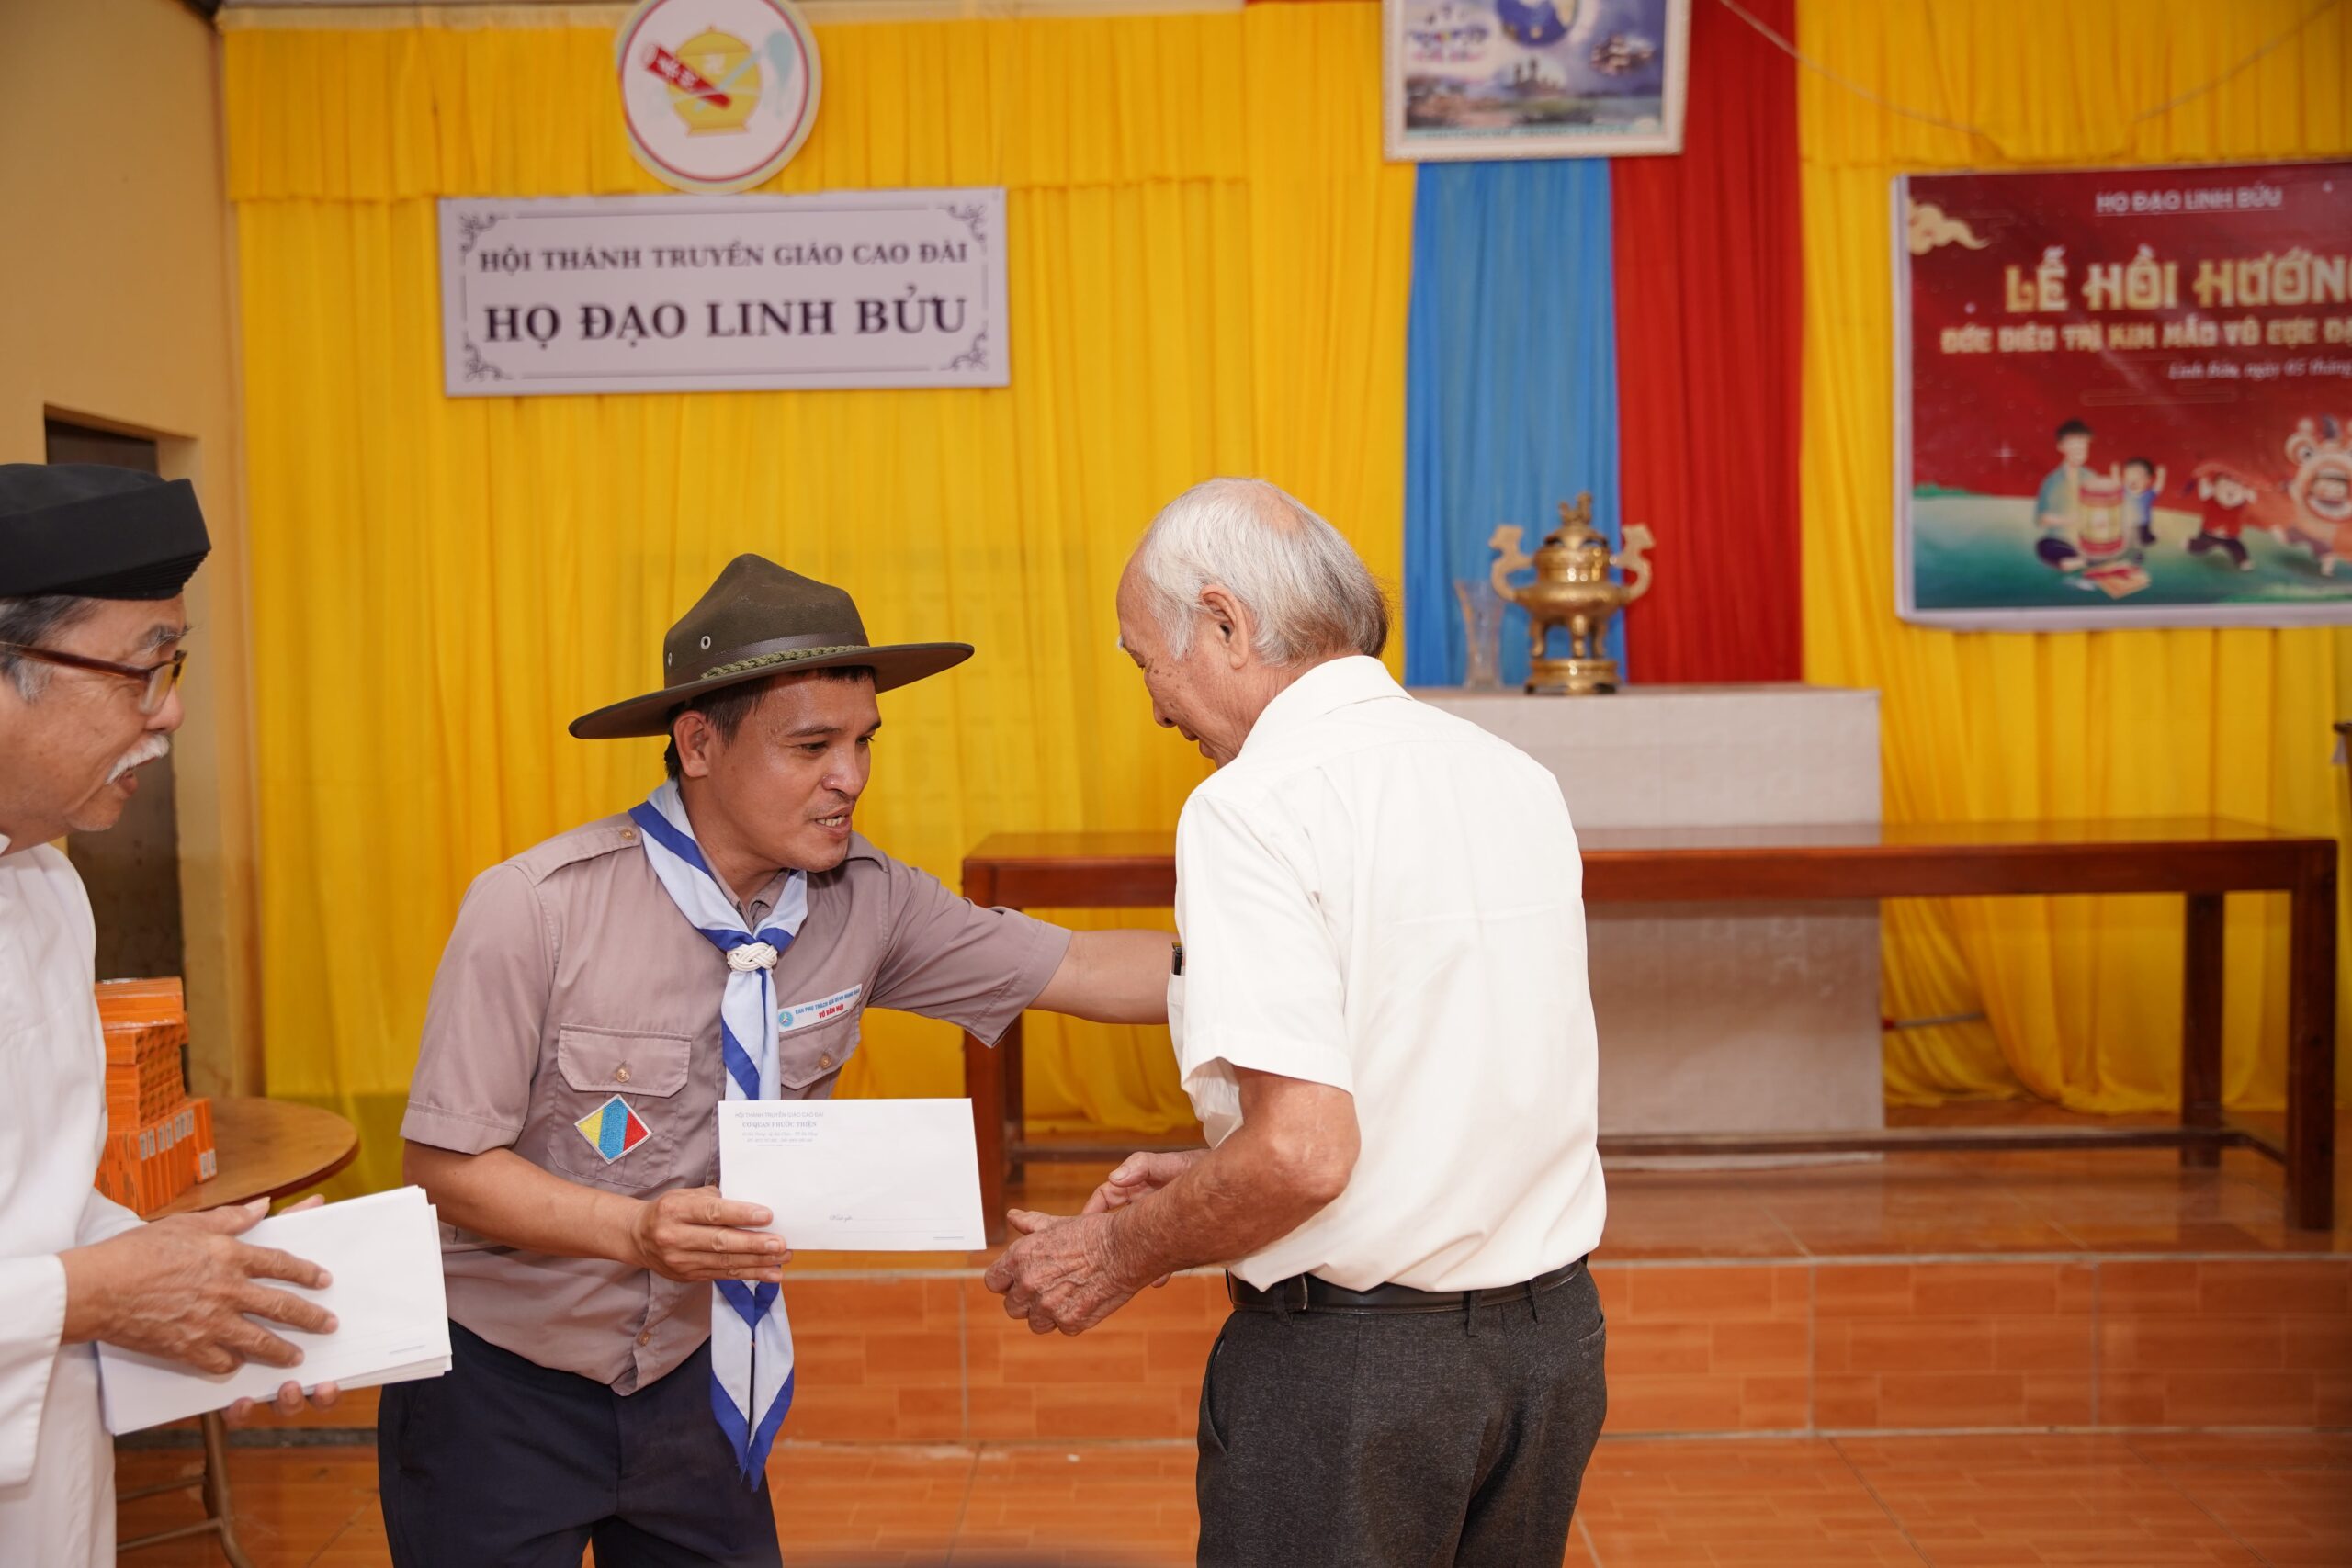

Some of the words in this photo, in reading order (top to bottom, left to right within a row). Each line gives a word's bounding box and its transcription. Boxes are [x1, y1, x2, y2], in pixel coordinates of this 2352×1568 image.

[2096, 191, 2129, 214] HỌ
[2132, 189, 2181, 213] ĐẠO
[2184, 186, 2233, 209] LINH
[480, 245, 532, 276] HỘI
[542, 244, 641, 271] THÁNH
[773, 241, 844, 267] GIÁO
[852, 243, 910, 265] CAO
[919, 240, 968, 264] ĐÀI
[2005, 245, 2068, 313] LỄ
[2192, 246, 2352, 309] HƯỚN
[484, 304, 561, 350] HỌ
[579, 301, 688, 348] ĐẠO
[706, 299, 838, 337] LINH
[854, 282, 967, 334] BỬU
[2222, 314, 2261, 346] VÔ
